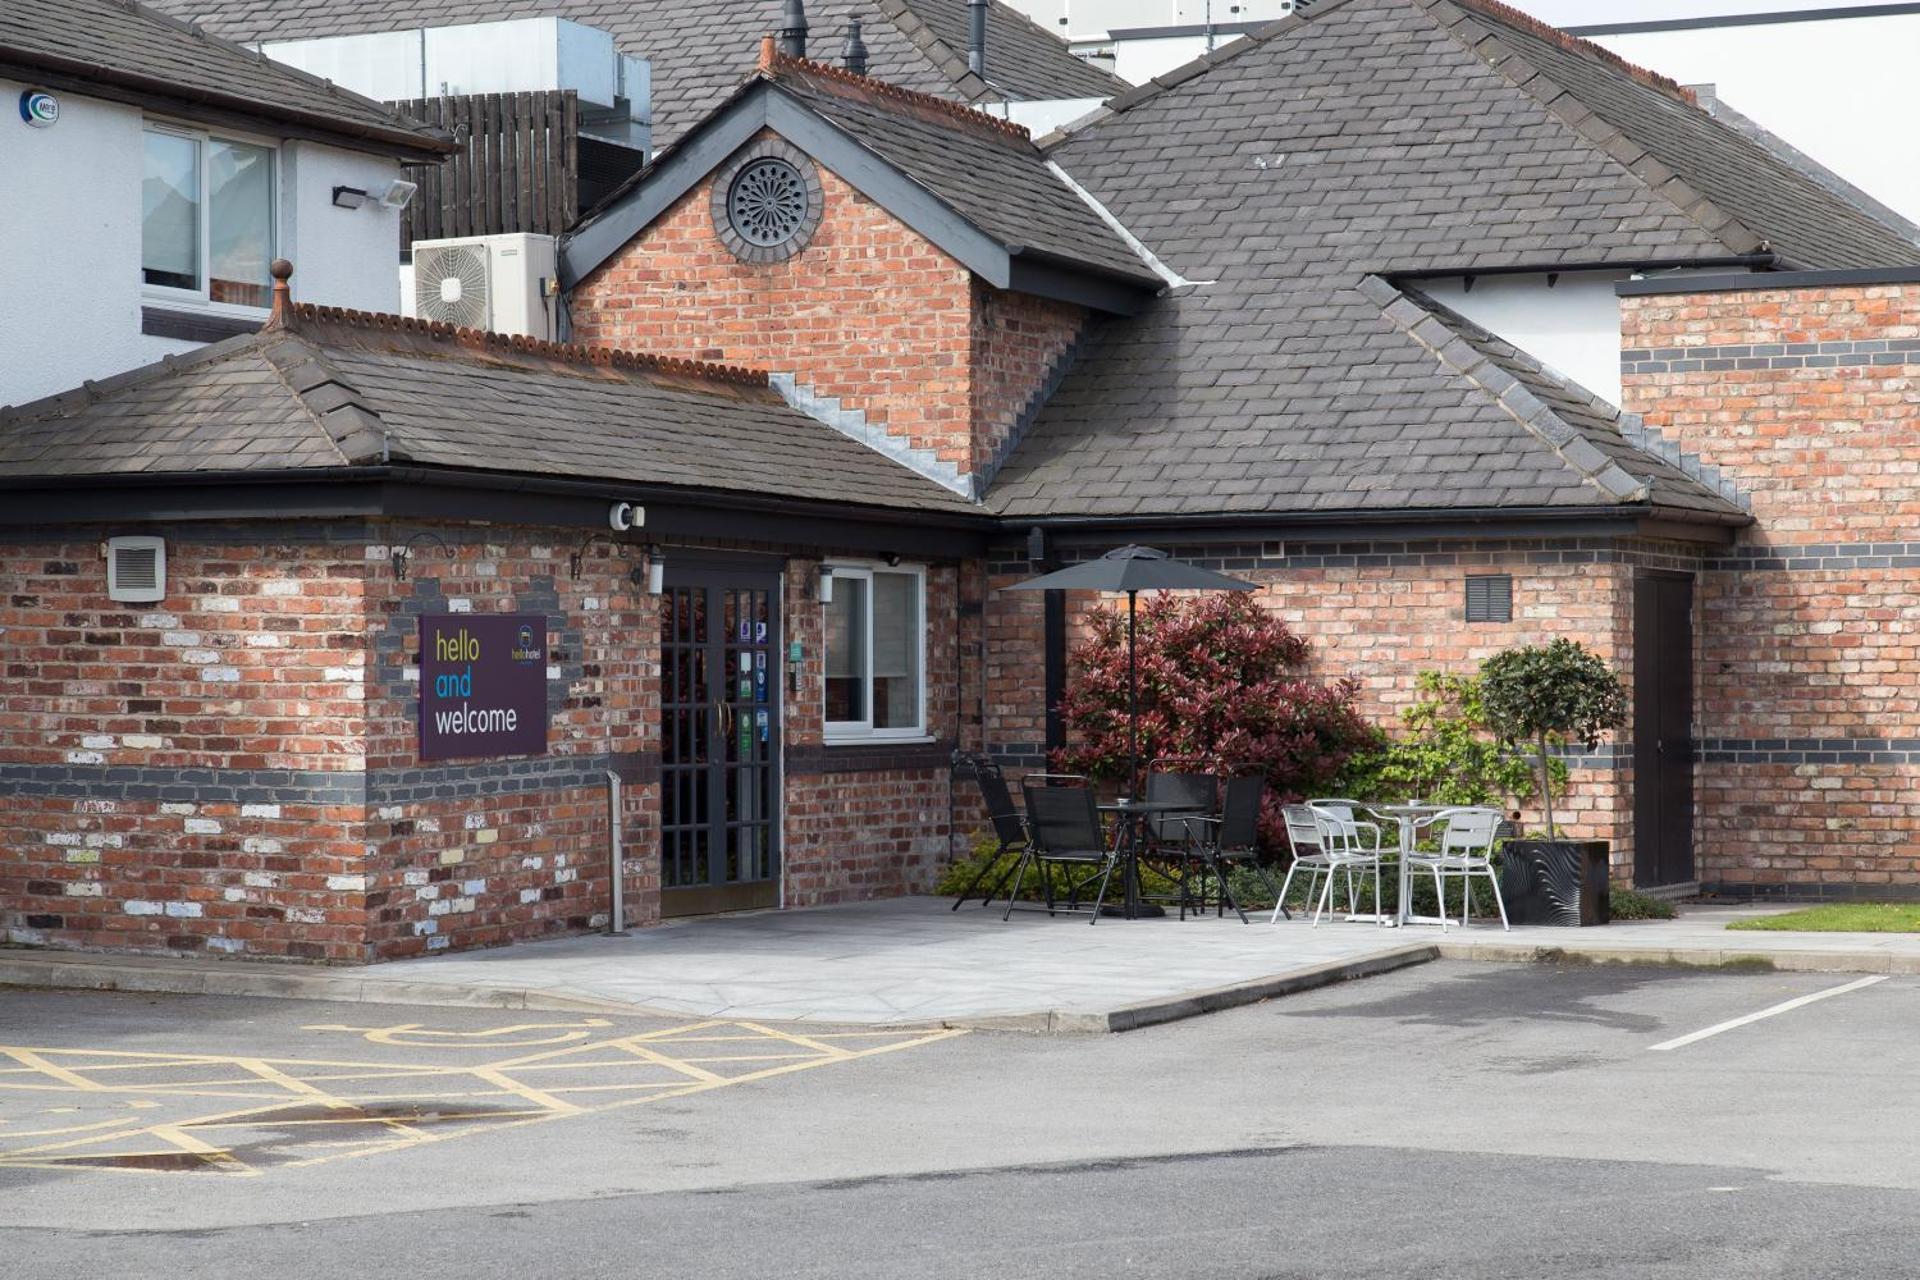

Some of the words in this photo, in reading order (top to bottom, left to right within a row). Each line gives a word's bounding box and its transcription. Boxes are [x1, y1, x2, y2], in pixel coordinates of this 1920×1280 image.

[436, 628, 480, 661] hello
[436, 665, 471, 698] and
[435, 701, 517, 735] welcome
